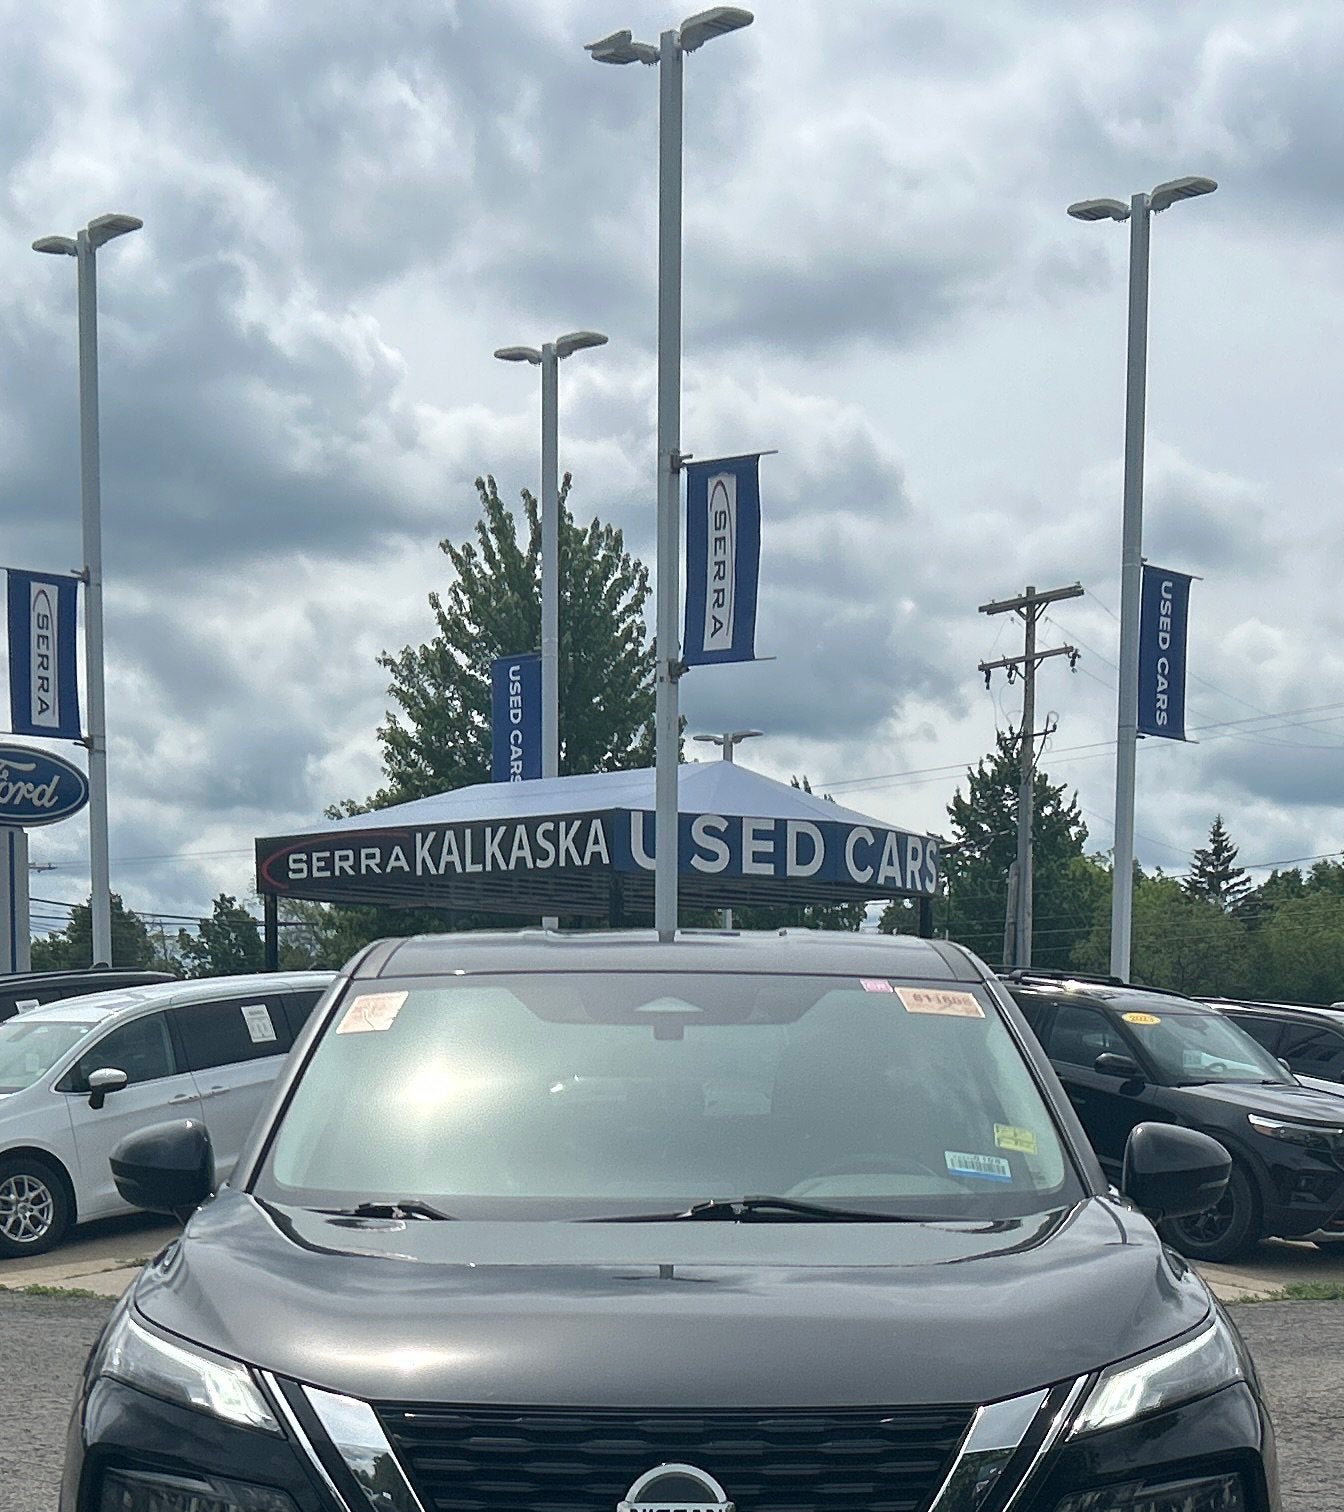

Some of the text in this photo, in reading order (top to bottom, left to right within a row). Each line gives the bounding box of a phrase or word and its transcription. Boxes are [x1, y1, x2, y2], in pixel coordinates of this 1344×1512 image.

[711, 510, 726, 638] SERRA
[35, 612, 49, 715] SERRA
[509, 664, 522, 724] USED
[1156, 581, 1172, 726] USED CARS
[288, 818, 610, 880] SERRA KALKASKA
[631, 811, 937, 894] USED CARS
